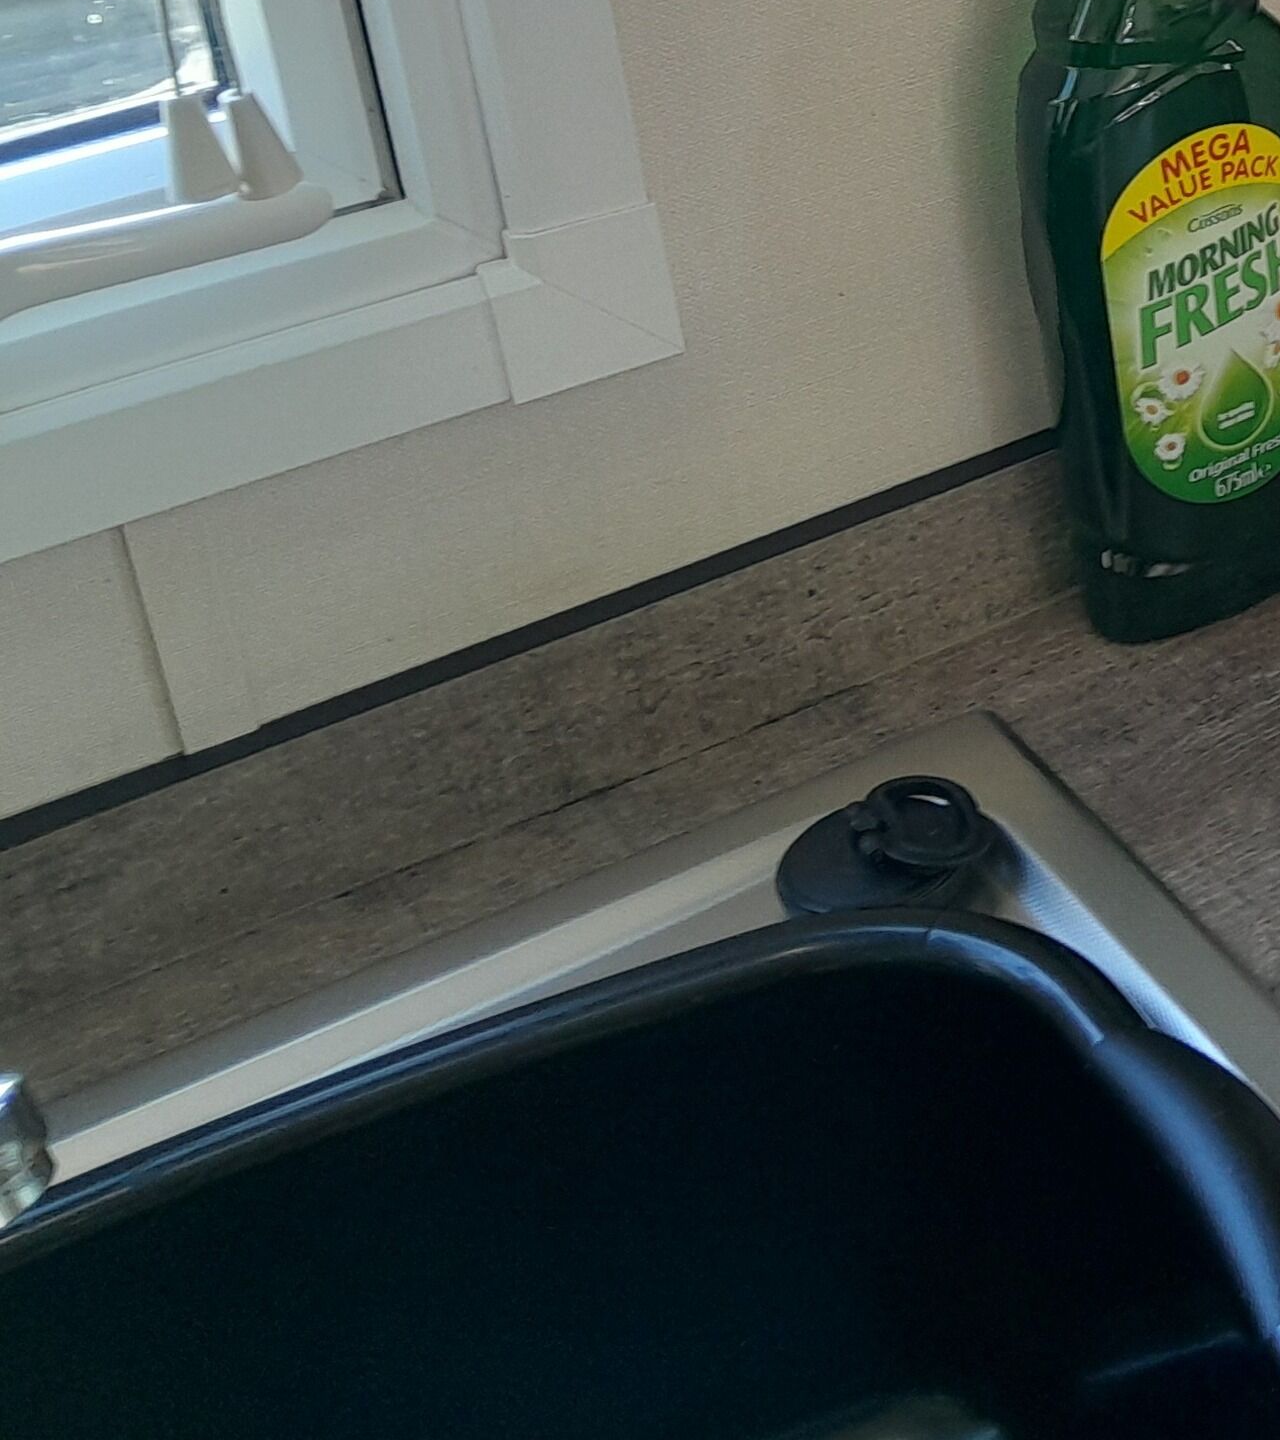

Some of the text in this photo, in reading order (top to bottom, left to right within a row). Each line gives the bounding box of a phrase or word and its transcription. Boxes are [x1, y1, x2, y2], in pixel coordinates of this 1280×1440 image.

[1160, 129, 1250, 183] MEGA
[1128, 155, 1279, 224] VALUE PACK
[1148, 202, 1280, 301] MORNING
[1188, 447, 1251, 482] Original
